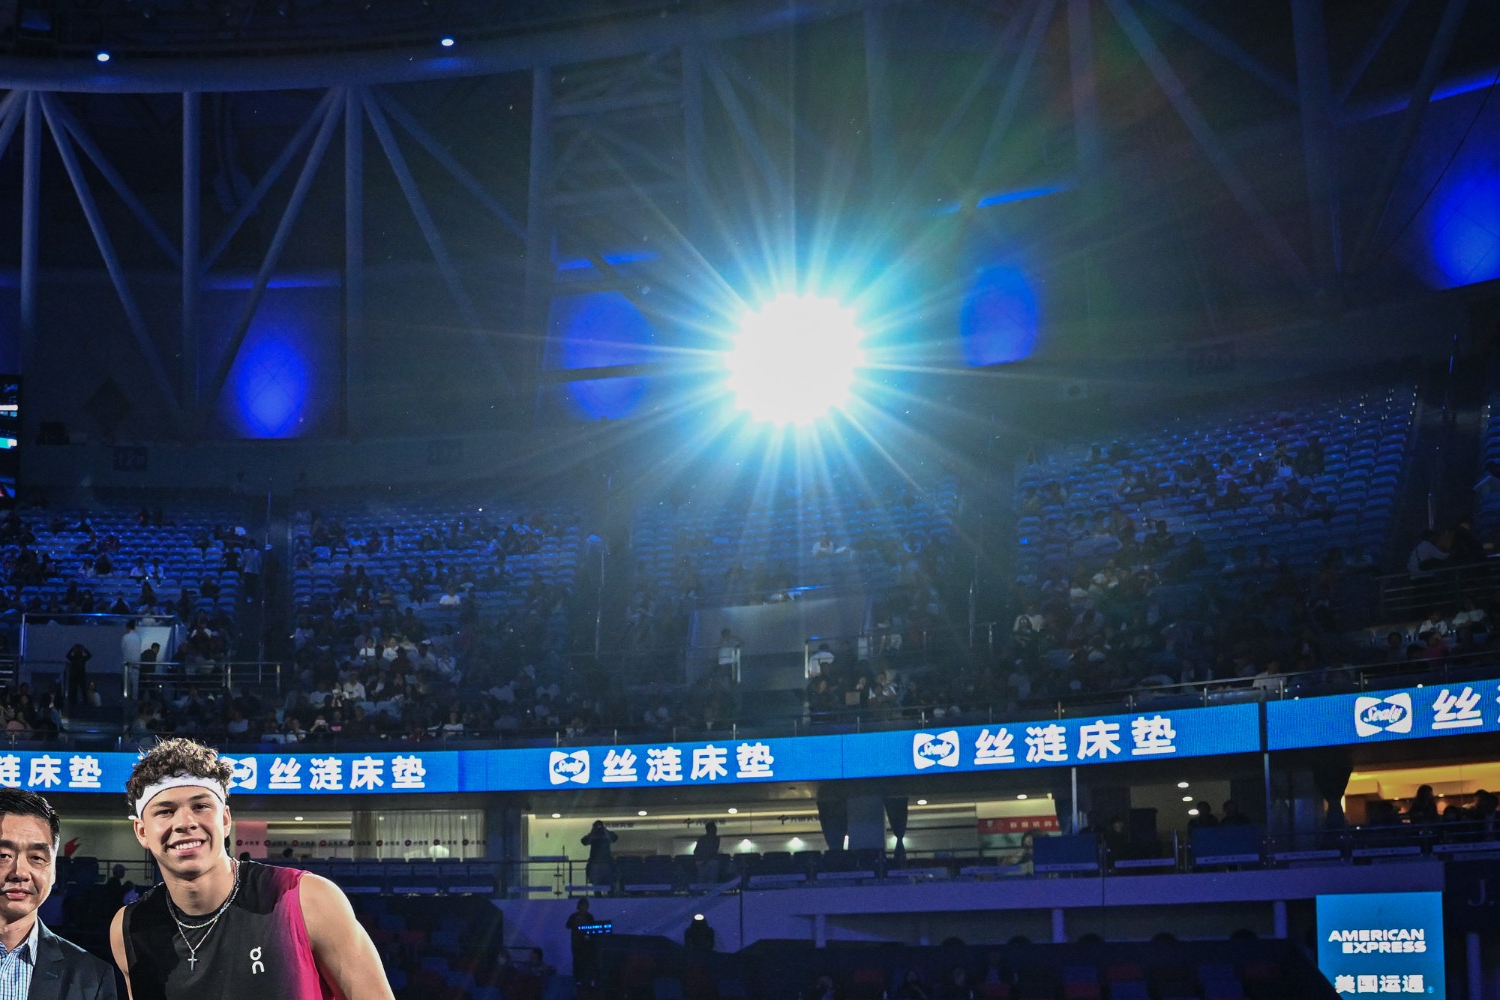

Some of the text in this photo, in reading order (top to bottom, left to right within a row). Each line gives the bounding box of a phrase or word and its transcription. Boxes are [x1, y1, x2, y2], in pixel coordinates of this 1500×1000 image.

[1431, 686, 1500, 730] 丝
[974, 715, 1177, 765] 丝涟床垫
[268, 755, 427, 790] 丝涟床垫
[602, 742, 775, 782] 丝涟床垫
[1328, 929, 1425, 942] AMERICAN
[1342, 941, 1426, 954] EXPRESS
[1334, 974, 1425, 994] 美国运通
